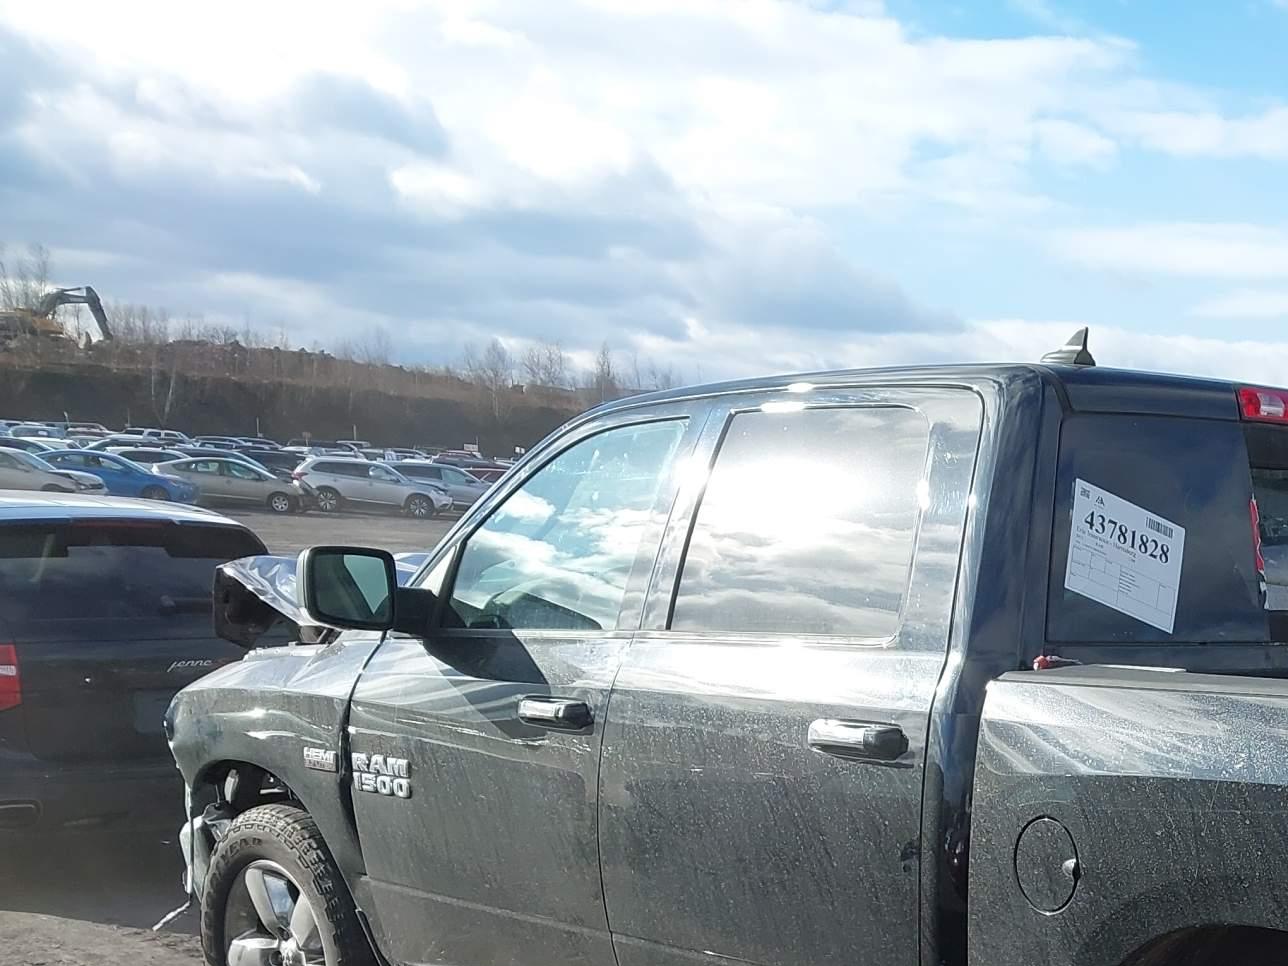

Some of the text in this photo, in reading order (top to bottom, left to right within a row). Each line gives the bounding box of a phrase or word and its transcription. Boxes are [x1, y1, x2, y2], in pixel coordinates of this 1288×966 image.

[1084, 510, 1170, 564] 43781828
[303, 747, 336, 767] HEMI
[352, 752, 410, 778] RAM
[353, 771, 412, 799] 1500
